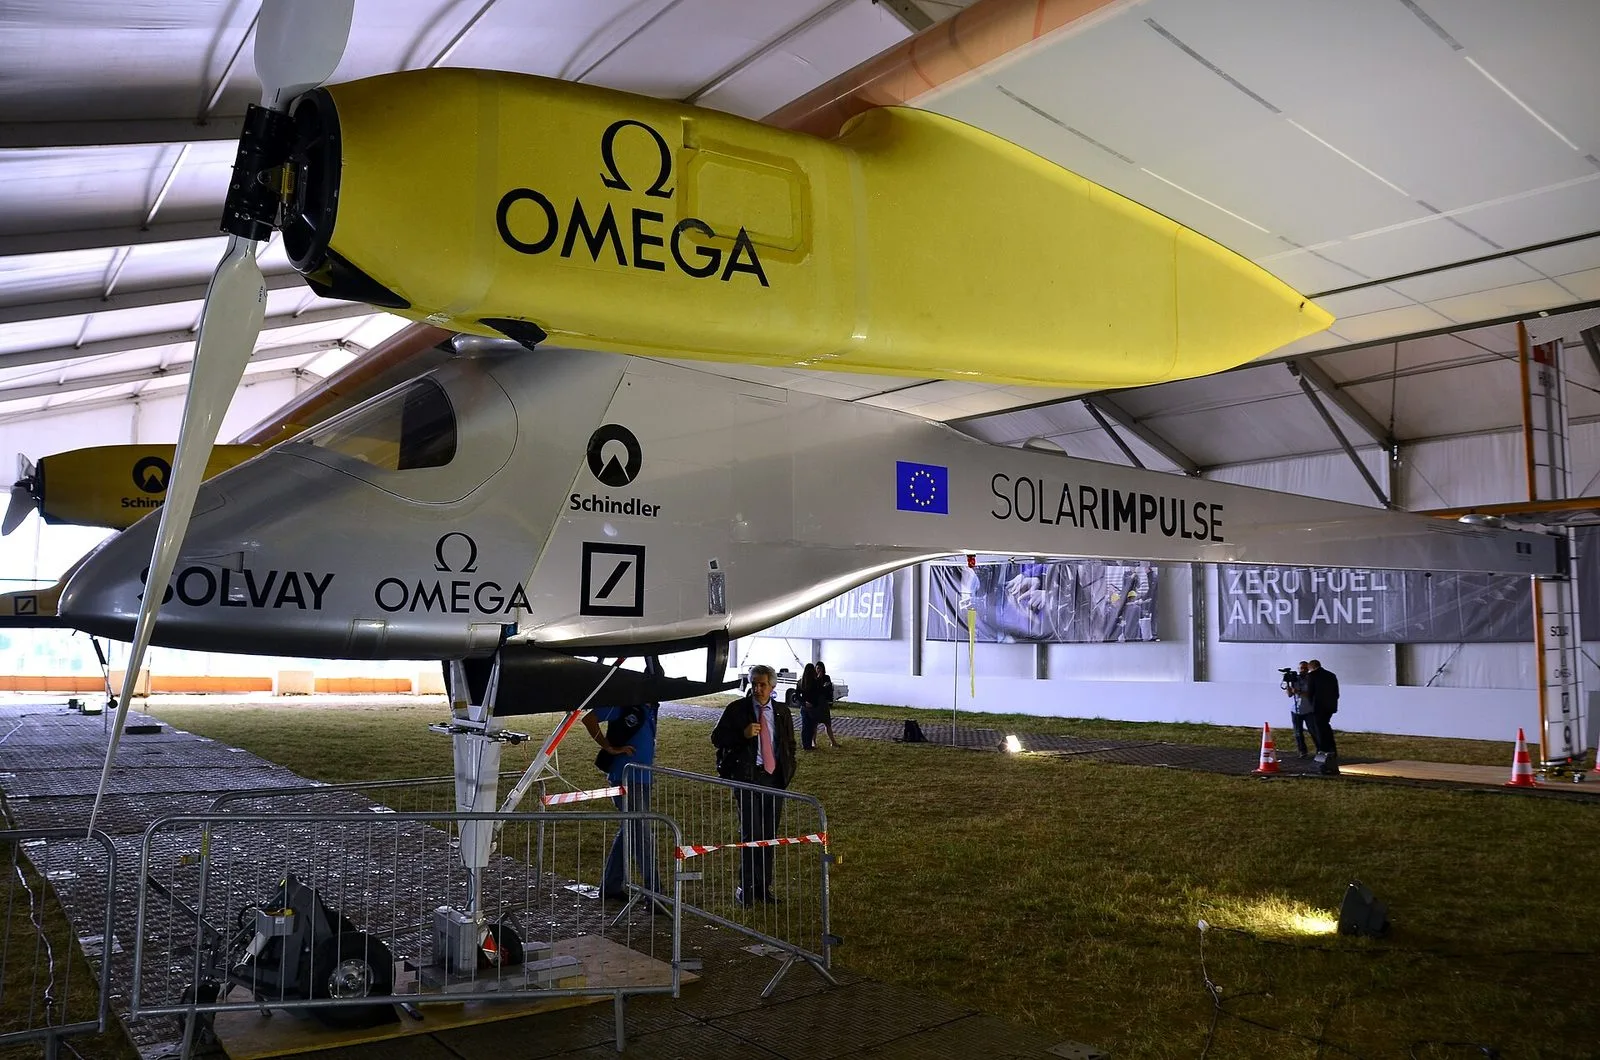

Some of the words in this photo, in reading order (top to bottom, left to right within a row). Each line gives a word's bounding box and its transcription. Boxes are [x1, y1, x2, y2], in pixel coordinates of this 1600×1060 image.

[496, 187, 770, 288] OMEGA
[570, 493, 661, 517] Schindler
[991, 473, 1225, 543] SOLARIMPULSE
[374, 577, 534, 615] OMEGA
[1228, 568, 1300, 595] ZERO
[1311, 568, 1388, 593] FUEL
[1228, 597, 1375, 625] AIRPLANE
